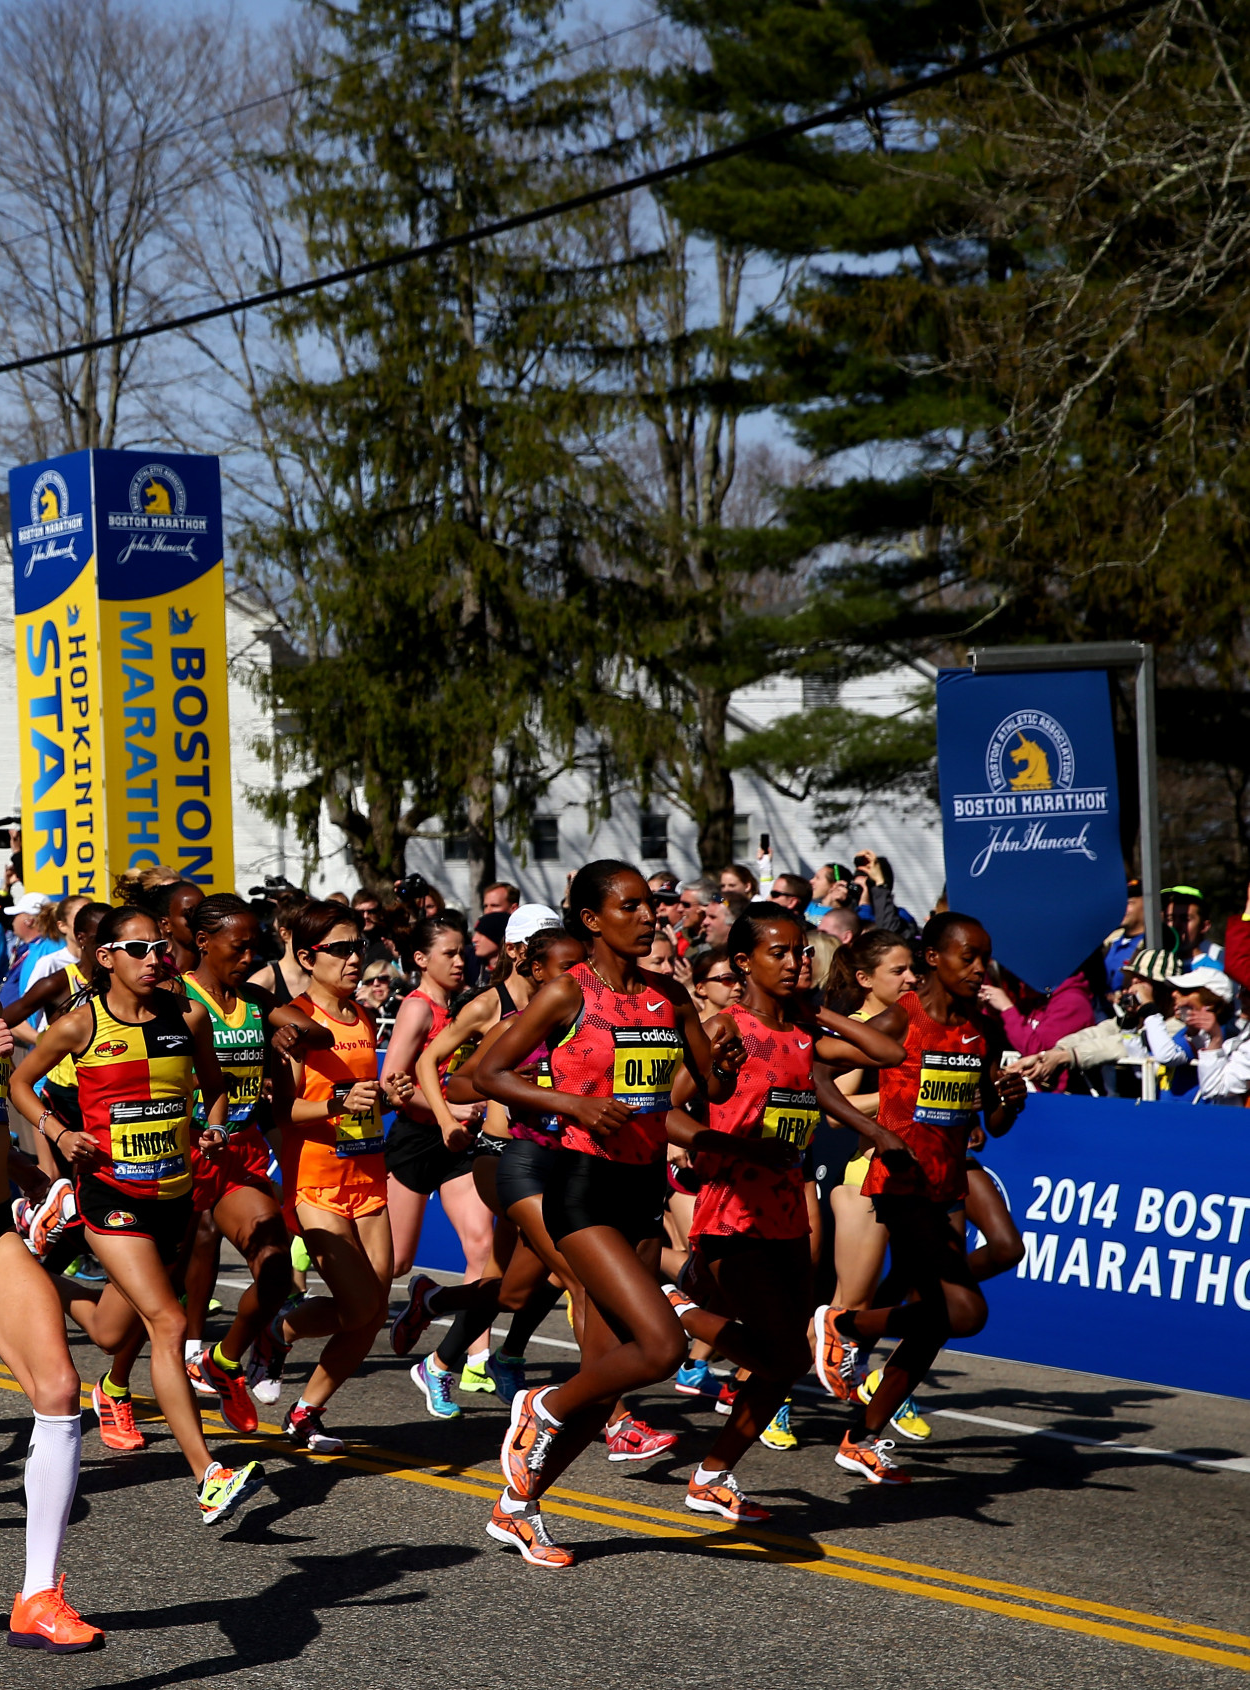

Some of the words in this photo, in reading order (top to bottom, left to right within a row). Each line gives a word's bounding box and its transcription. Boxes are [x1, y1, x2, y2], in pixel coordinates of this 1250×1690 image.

[108, 515, 149, 528] BOSTON
[151, 516, 207, 530] MARATHON
[66, 633, 96, 895] HOPKINTON
[170, 647, 214, 885] BOSTON
[953, 797, 1017, 817] BOSTON
[1021, 792, 1107, 813] MARATHON
[970, 824, 1021, 877] John
[1020, 821, 1097, 862] Hancock
[233, 1049, 264, 1061] adidas
[333, 1041, 357, 1051] okyo
[948, 1055, 982, 1067] adidas
[790, 1092, 817, 1105] adidas
[144, 1102, 184, 1116] adidas
[121, 1128, 179, 1158] LINDEN
[1025, 1175, 1120, 1229] 2014
[1134, 1187, 1250, 1244] BOST
